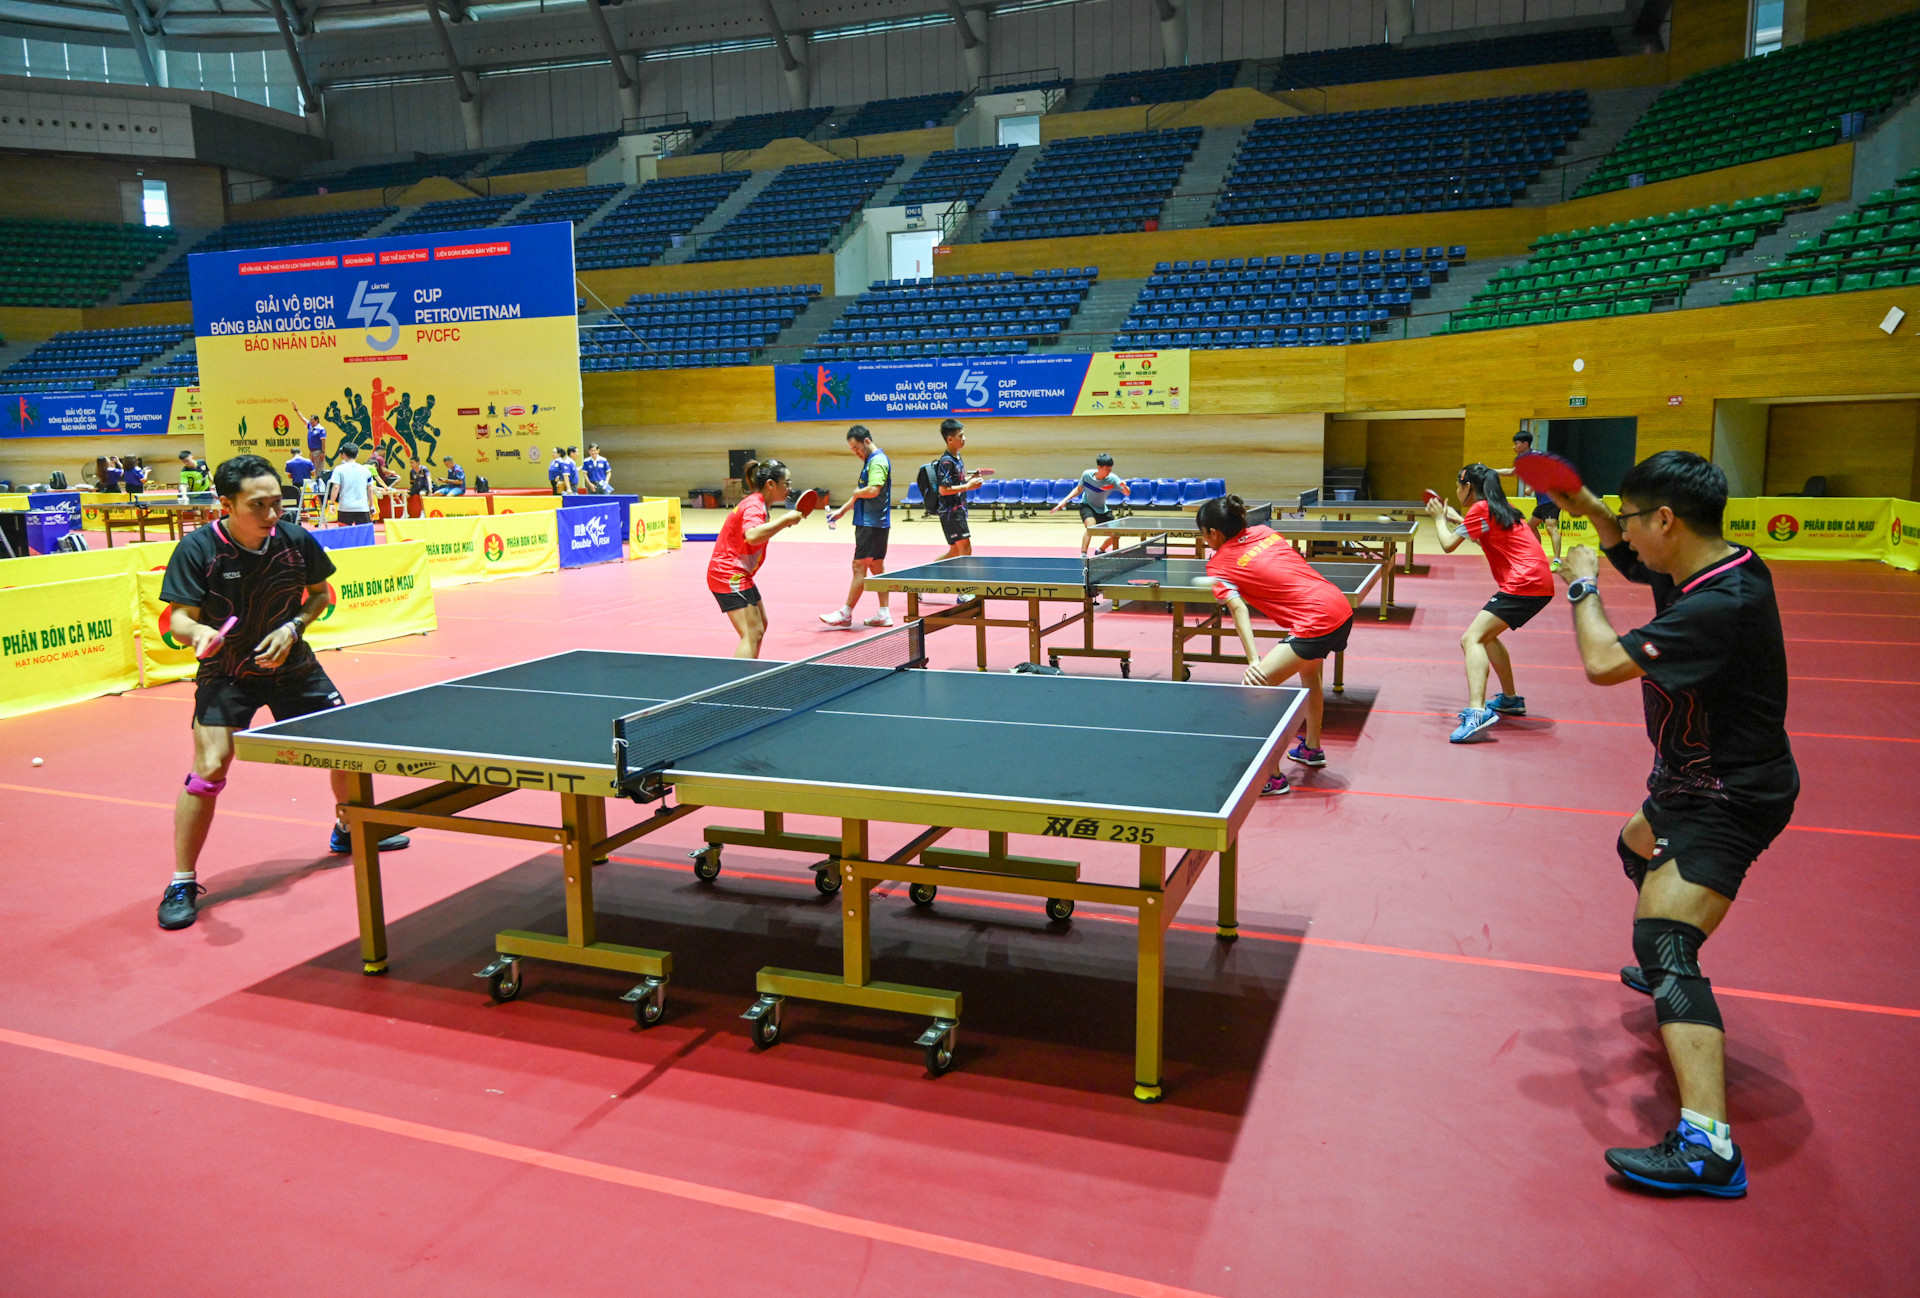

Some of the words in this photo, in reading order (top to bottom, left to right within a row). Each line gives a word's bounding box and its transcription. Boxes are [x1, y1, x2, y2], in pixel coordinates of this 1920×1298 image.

[414, 288, 442, 304] CUP
[255, 294, 280, 314] GIẢI
[282, 294, 300, 312] VÔ
[303, 296, 334, 313] ĐỊCH
[415, 303, 521, 323] PETROVIETNAM
[210, 318, 245, 335] BÓNG
[247, 316, 273, 333] BÀN
[276, 311, 311, 331] QUỐC
[314, 315, 336, 329] GIA
[245, 334, 269, 352] BÁO
[273, 333, 308, 350] NHÂN
[311, 331, 336, 348] DÂN
[416, 328, 461, 343] PVCFC
[896, 380, 912, 390] GIẢI
[914, 380, 926, 390] VÔ
[927, 382, 948, 391] ĐỊCH
[998, 380, 1017, 388] CUP
[865, 392, 888, 402] BÓNG
[890, 391, 906, 401] BÀN
[908, 390, 932, 400] QUỐC
[933, 392, 948, 400] GIA
[999, 389, 1065, 398] PETROVIETNAM
[886, 402, 903, 411] BÁO
[905, 401, 928, 410] NHÂN
[930, 400, 948, 410] DÂN
[999, 401, 1027, 409] PVCFC
[48, 416, 62, 424] BÓNG
[1573, 520, 1587, 530] MAU
[1730, 519, 1749, 530] PHÂN
[1804, 518, 1825, 530] PHÂN
[1827, 518, 1842, 531] BÓN
[1845, 518, 1855, 531] CÀ
[1858, 521, 1875, 531] MAU
[441, 542, 452, 554] BÓN
[462, 541, 474, 552] MAU
[507, 536, 519, 548] PHÂN
[521, 536, 530, 546] BÓN
[538, 534, 548, 544] MAU
[572, 538, 592, 550] Double
[598, 536, 610, 545] FISH
[341, 580, 364, 600] PHÂN
[366, 578, 382, 596] BÓN
[384, 575, 395, 593] CÀ
[397, 574, 414, 590] MAU
[986, 586, 1058, 597] MOFIT
[2, 629, 38, 656] PHÂN
[40, 625, 66, 649] BÓN
[68, 620, 85, 644] CÀ
[87, 618, 112, 640] MAU
[15, 658, 31, 669] HẠT
[33, 653, 60, 664] NGỌC
[62, 649, 80, 660] MÙA
[81, 644, 105, 655] VÀNG
[303, 754, 340, 769] DOUBLE
[342, 760, 363, 771] FISH
[451, 764, 585, 792] MOFIT
[1042, 816, 1100, 840] 双鱼
[1110, 825, 1155, 844] 235
